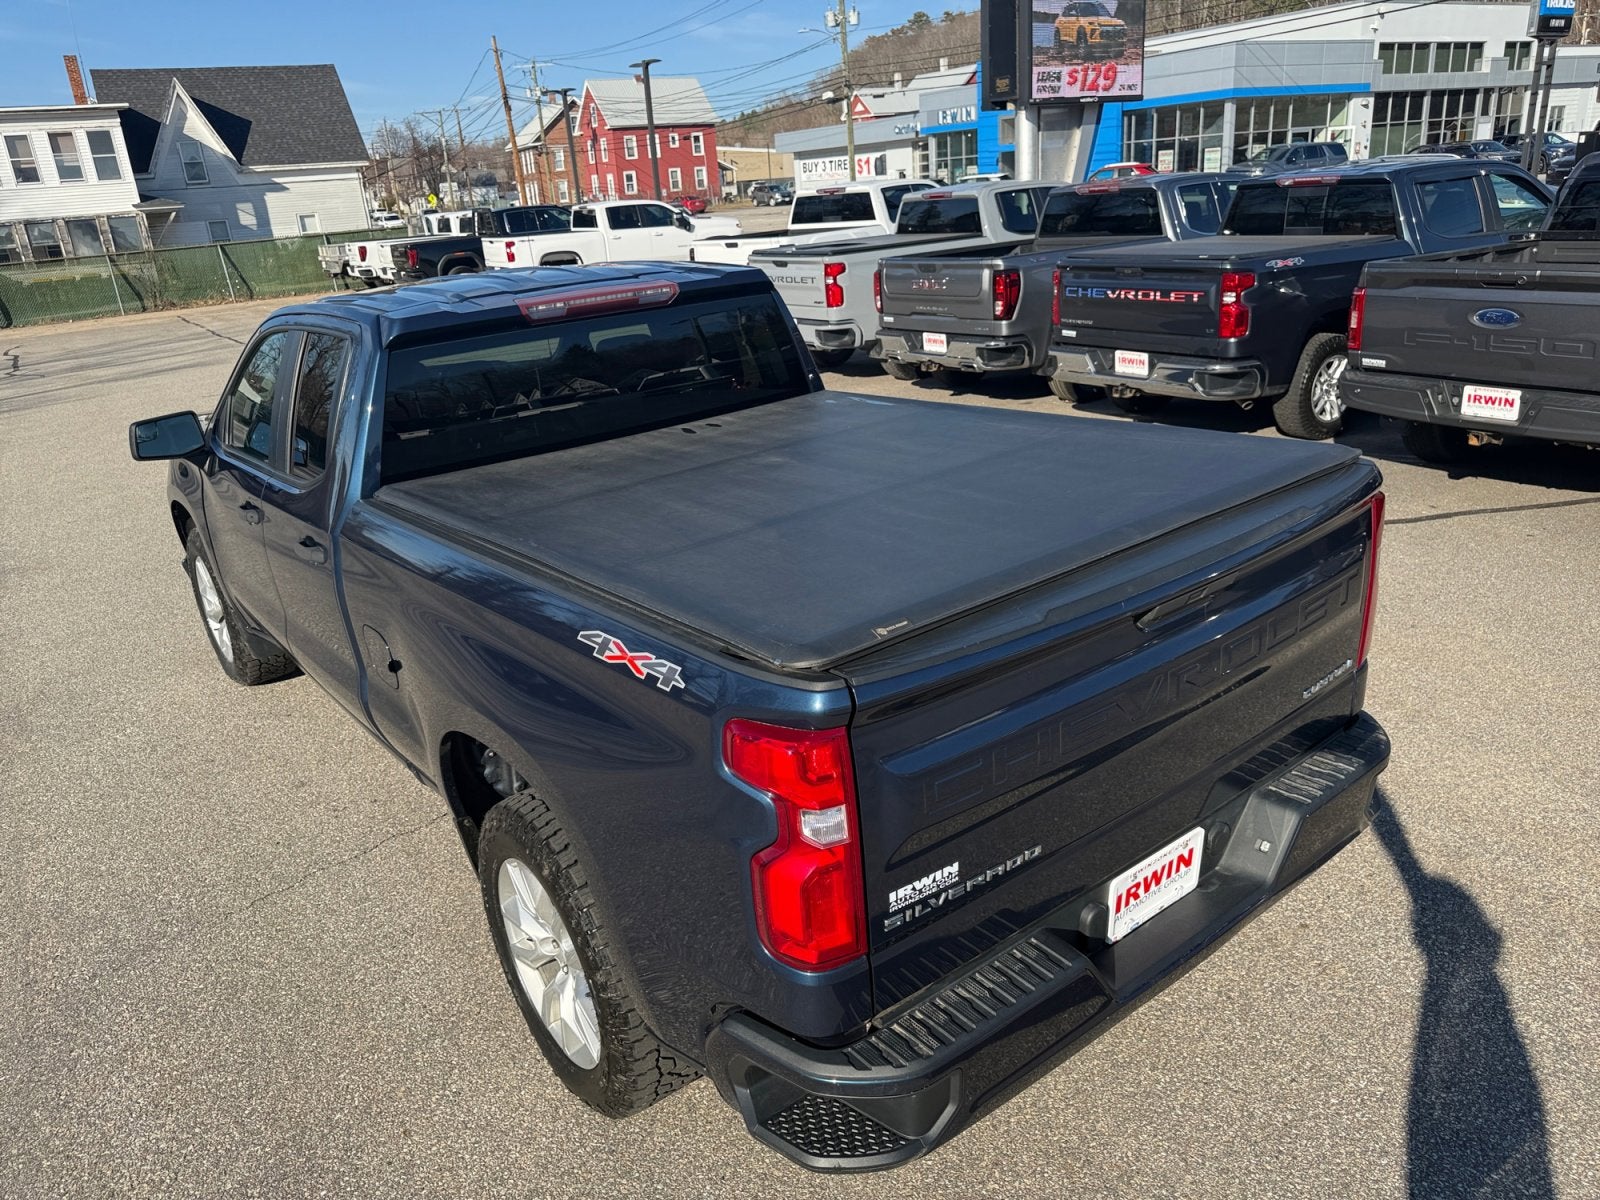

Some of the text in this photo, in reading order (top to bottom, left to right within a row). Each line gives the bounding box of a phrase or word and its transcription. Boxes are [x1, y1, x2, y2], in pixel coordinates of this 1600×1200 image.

[1066, 61, 1117, 92] $129
[938, 105, 976, 125] IRWIN
[803, 157, 871, 175] BUY 3 TIRE $1
[769, 276, 816, 284] VROLET
[1065, 287, 1205, 303] CHEVROLET
[1404, 329, 1597, 360] F-150
[1118, 356, 1145, 367] IRWIN
[1467, 393, 1515, 408] IRWIN
[924, 566, 1362, 814] CHEVROLET
[884, 845, 1042, 932] SILVERADO
[889, 862, 959, 903] IRWIN
[889, 871, 959, 909] AUTO GROUP
[889, 876, 959, 913] IRWINZONE.COM
[1114, 868, 1191, 922] AUTOMOTIVE GROUP
[1115, 847, 1194, 915] IRWIN
